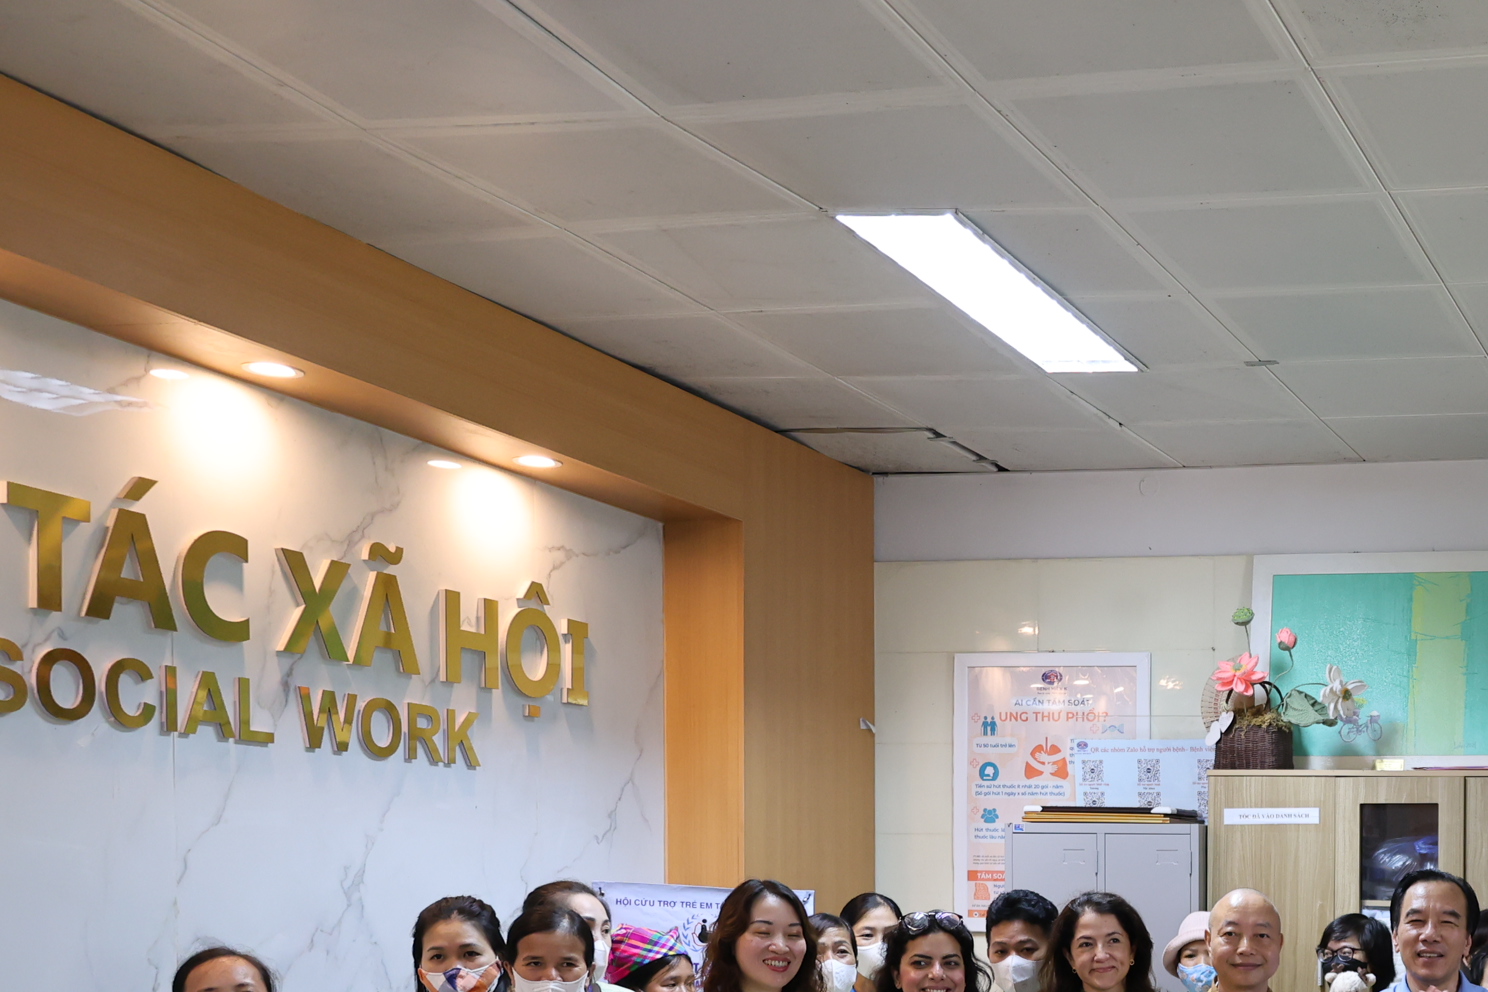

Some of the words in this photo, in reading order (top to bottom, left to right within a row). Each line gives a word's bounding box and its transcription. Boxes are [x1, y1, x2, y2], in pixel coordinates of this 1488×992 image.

[0, 476, 250, 643] TÁC
[274, 541, 421, 675] XÃ
[438, 580, 589, 718] HỘI
[0, 637, 275, 745] SOCIAL
[297, 685, 481, 768] WORK
[999, 711, 1029, 722] UNG
[1033, 710, 1062, 722] THƯ
[615, 897, 632, 906] HỘI
[634, 898, 655, 907] CỨU
[658, 900, 678, 909] TRỢ
